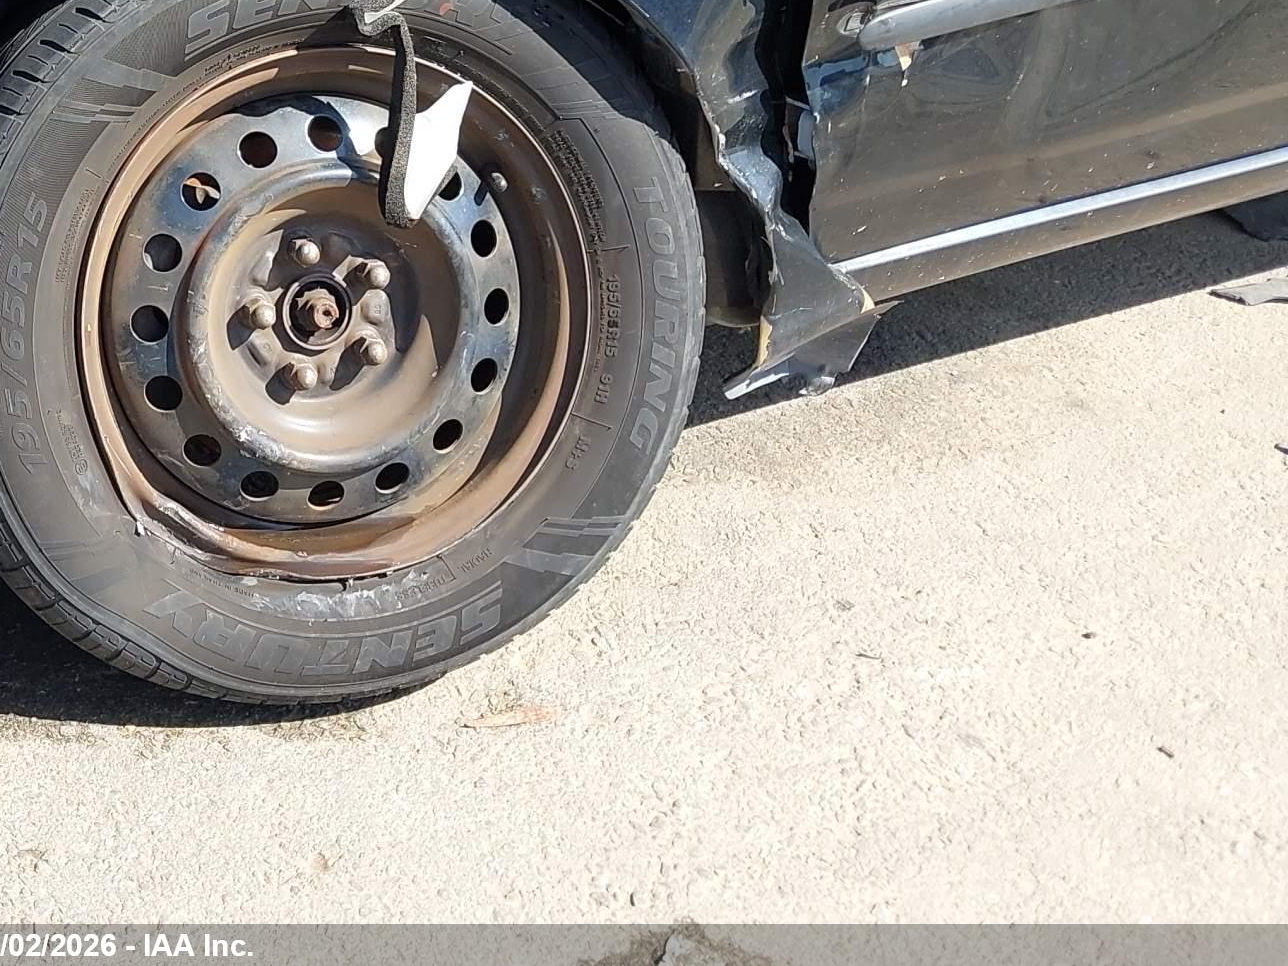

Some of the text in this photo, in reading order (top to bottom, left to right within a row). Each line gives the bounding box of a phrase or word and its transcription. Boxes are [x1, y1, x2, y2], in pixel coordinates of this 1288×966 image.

[0, 192, 48, 474] 195/65R15
[604, 274, 622, 358] 195/65R15
[629, 176, 681, 455] TOURING
[594, 374, 613, 404] 91H
[143, 587, 503, 676] SENTURY
